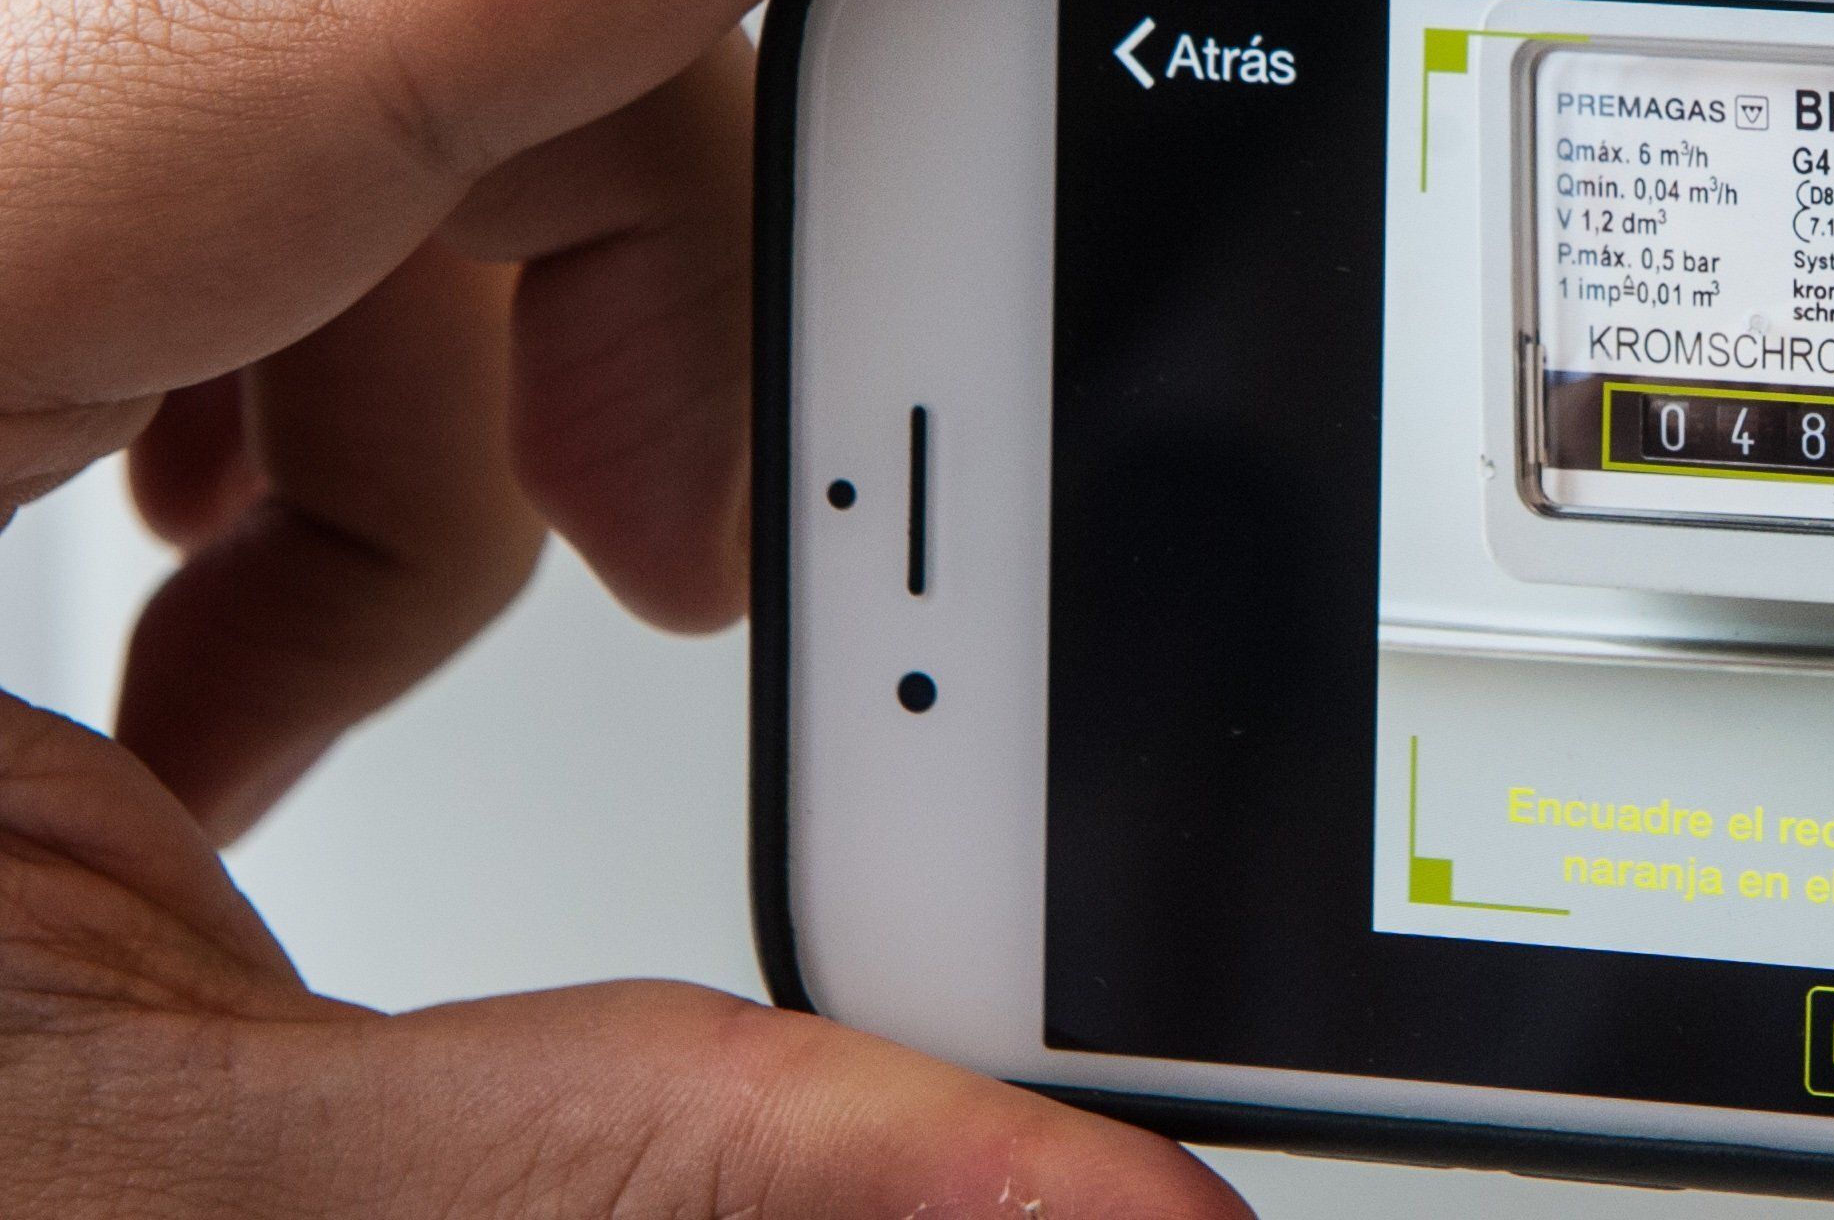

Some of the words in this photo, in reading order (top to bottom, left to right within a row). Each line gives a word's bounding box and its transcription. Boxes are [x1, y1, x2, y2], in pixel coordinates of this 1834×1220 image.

[1165, 34, 1297, 85] Atrás
[1556, 92, 1727, 124] PREMAGAS
[1556, 137, 1630, 164] Qmáx.
[1638, 142, 1652, 165] 6
[1792, 146, 1831, 176] G4
[1633, 177, 1680, 205] 0,04
[1556, 208, 1573, 230] V
[1582, 210, 1614, 235] 1,2
[1558, 242, 1632, 269] P.máx.
[1641, 247, 1675, 275] 0,5
[1683, 250, 1722, 274] bar
[1559, 277, 1569, 300] 1
[1507, 786, 1713, 838] Encuadre
[1727, 806, 1764, 842] el
[1562, 854, 1725, 901] naranja
[1738, 869, 1790, 899] en
